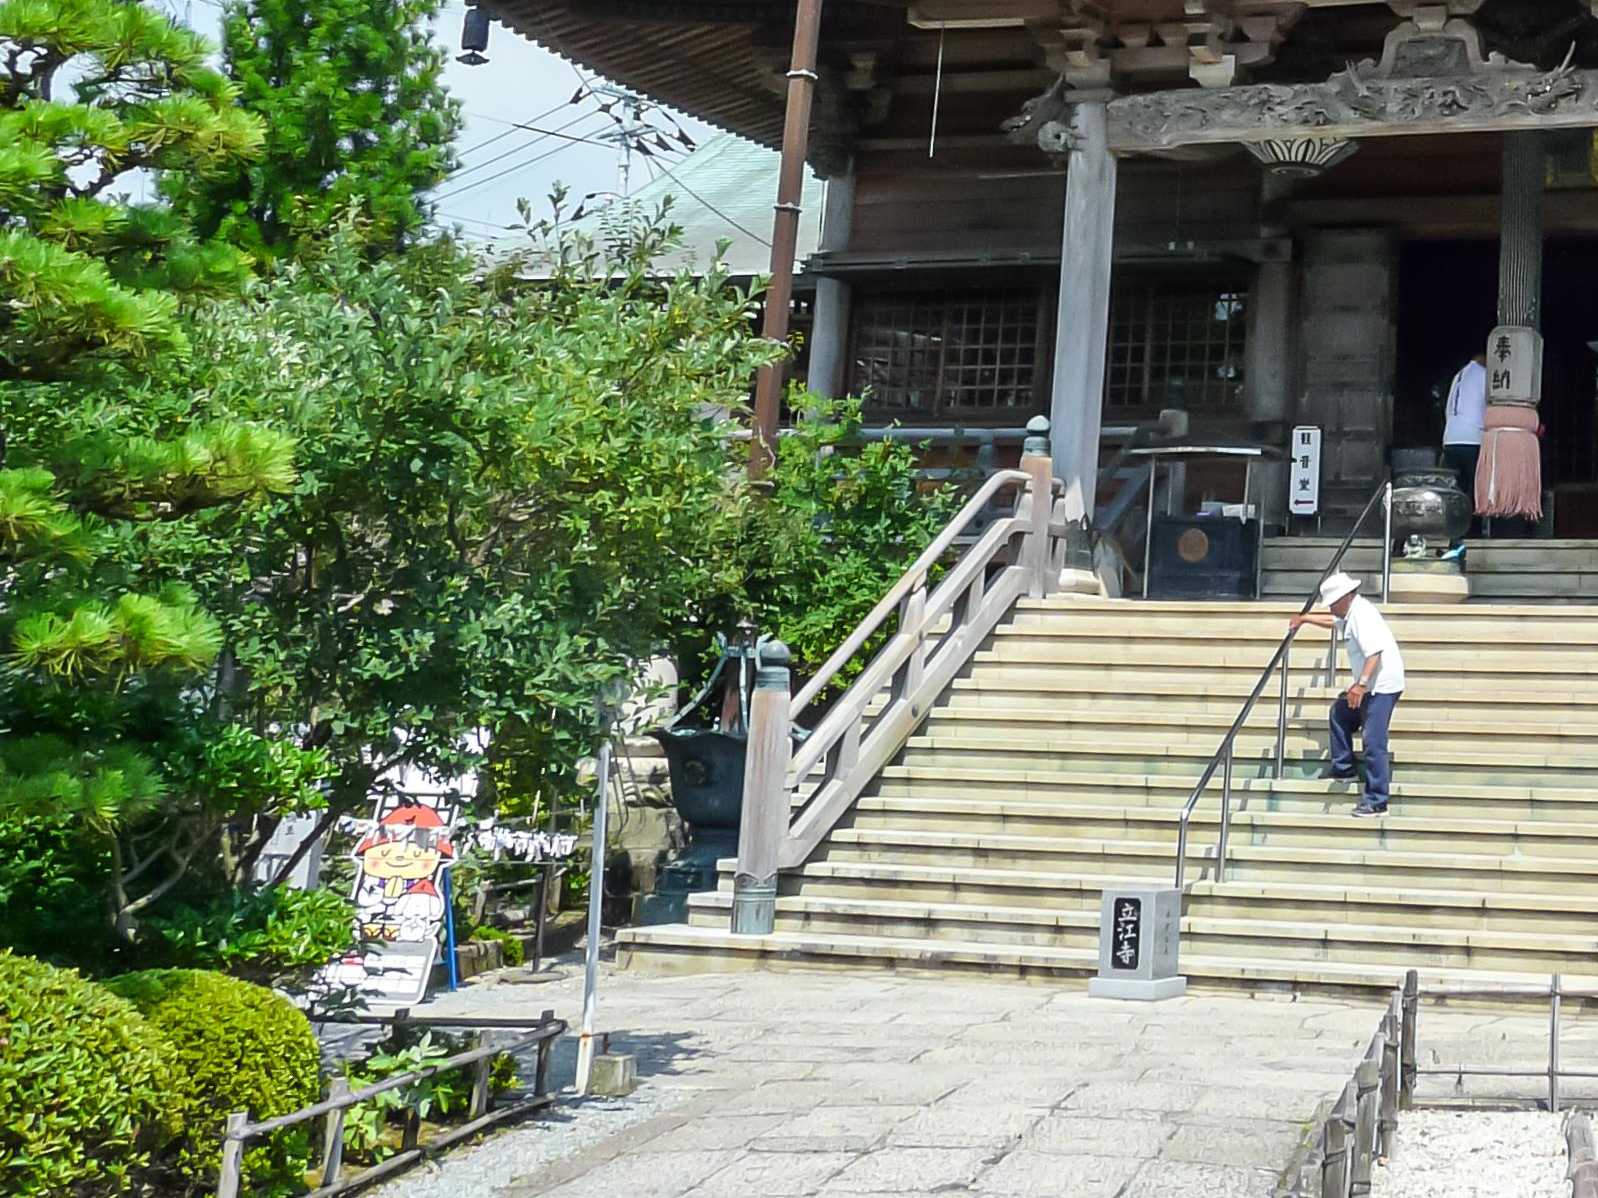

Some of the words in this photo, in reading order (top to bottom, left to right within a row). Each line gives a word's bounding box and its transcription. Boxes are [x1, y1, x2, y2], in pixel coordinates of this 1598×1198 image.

[1492, 335, 1511, 390] 奉納
[1116, 903, 1137, 965] 立江寺
